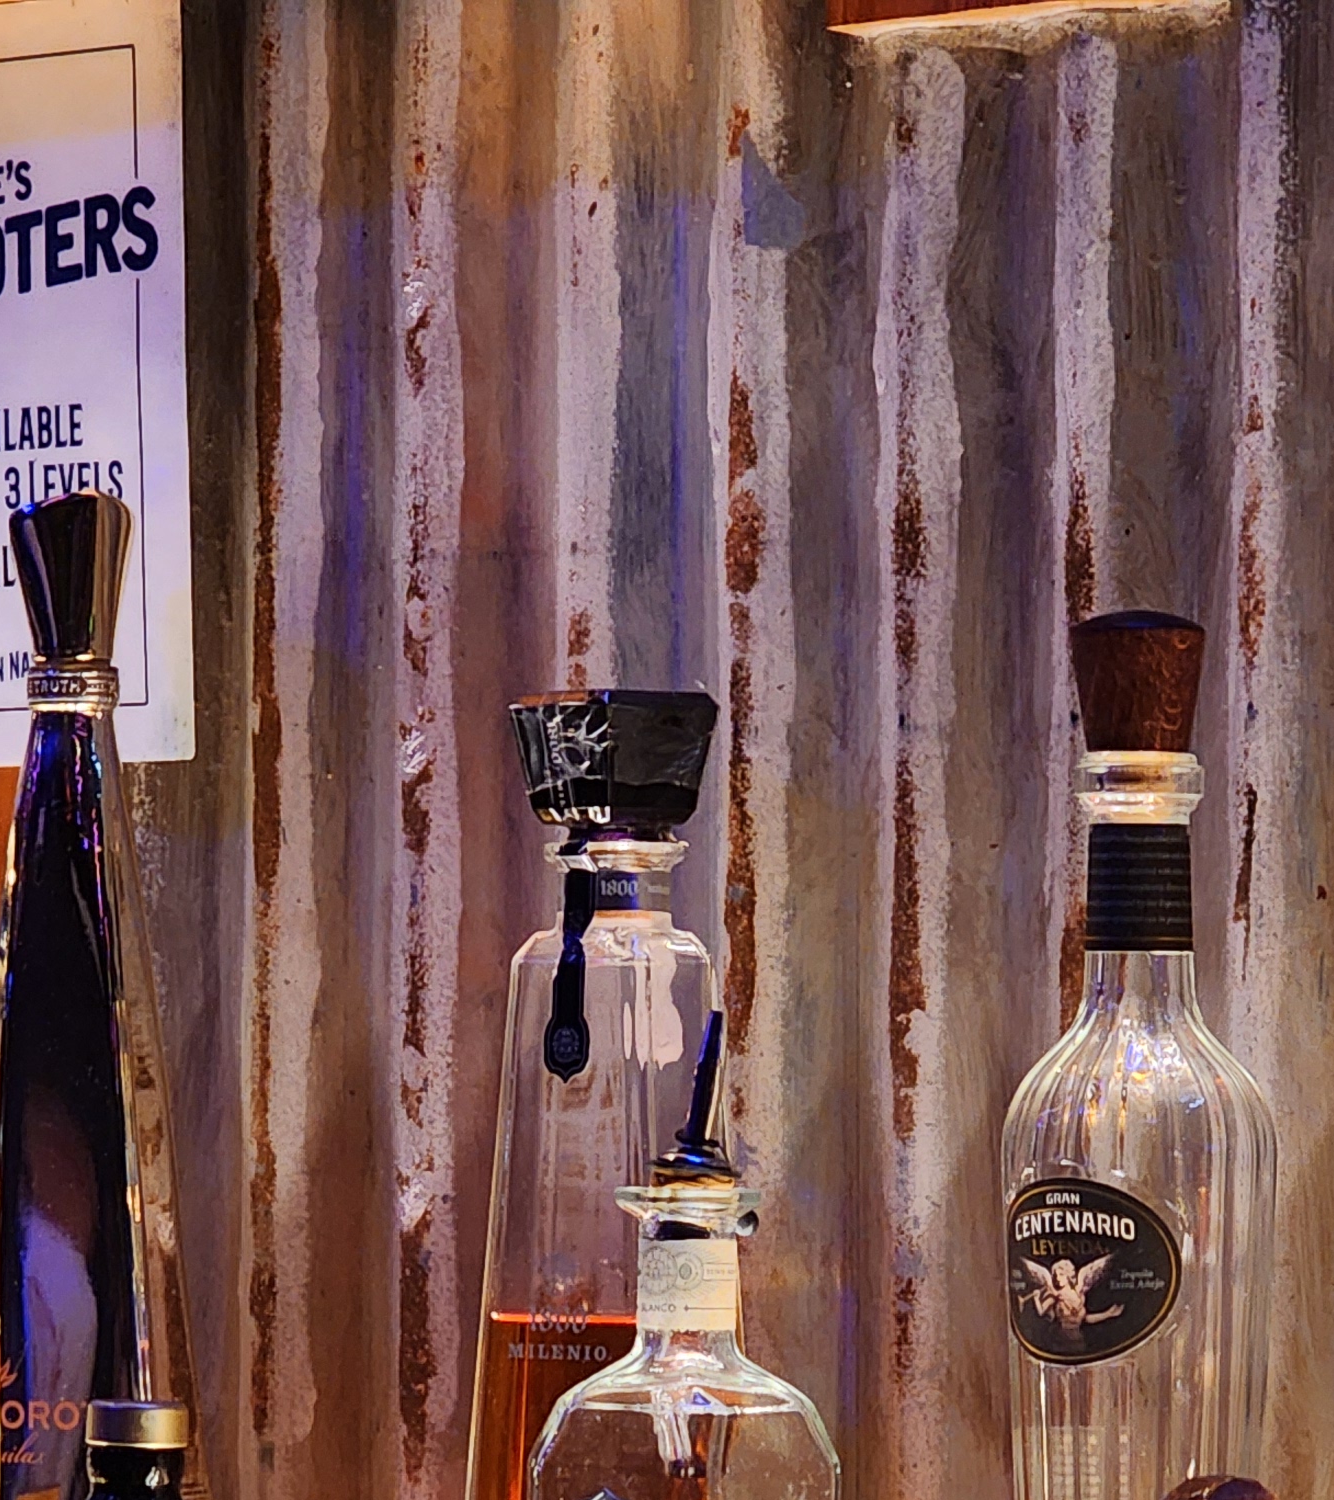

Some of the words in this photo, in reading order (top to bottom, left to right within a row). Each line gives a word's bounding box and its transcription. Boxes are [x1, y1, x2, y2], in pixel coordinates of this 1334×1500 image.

[4, 466, 21, 509] 3
[600, 879, 638, 897] 1800
[1045, 1192, 1081, 1206] GRAN
[1014, 1210, 1136, 1242] CENTENARIO
[508, 1343, 609, 1362] MILENIO
